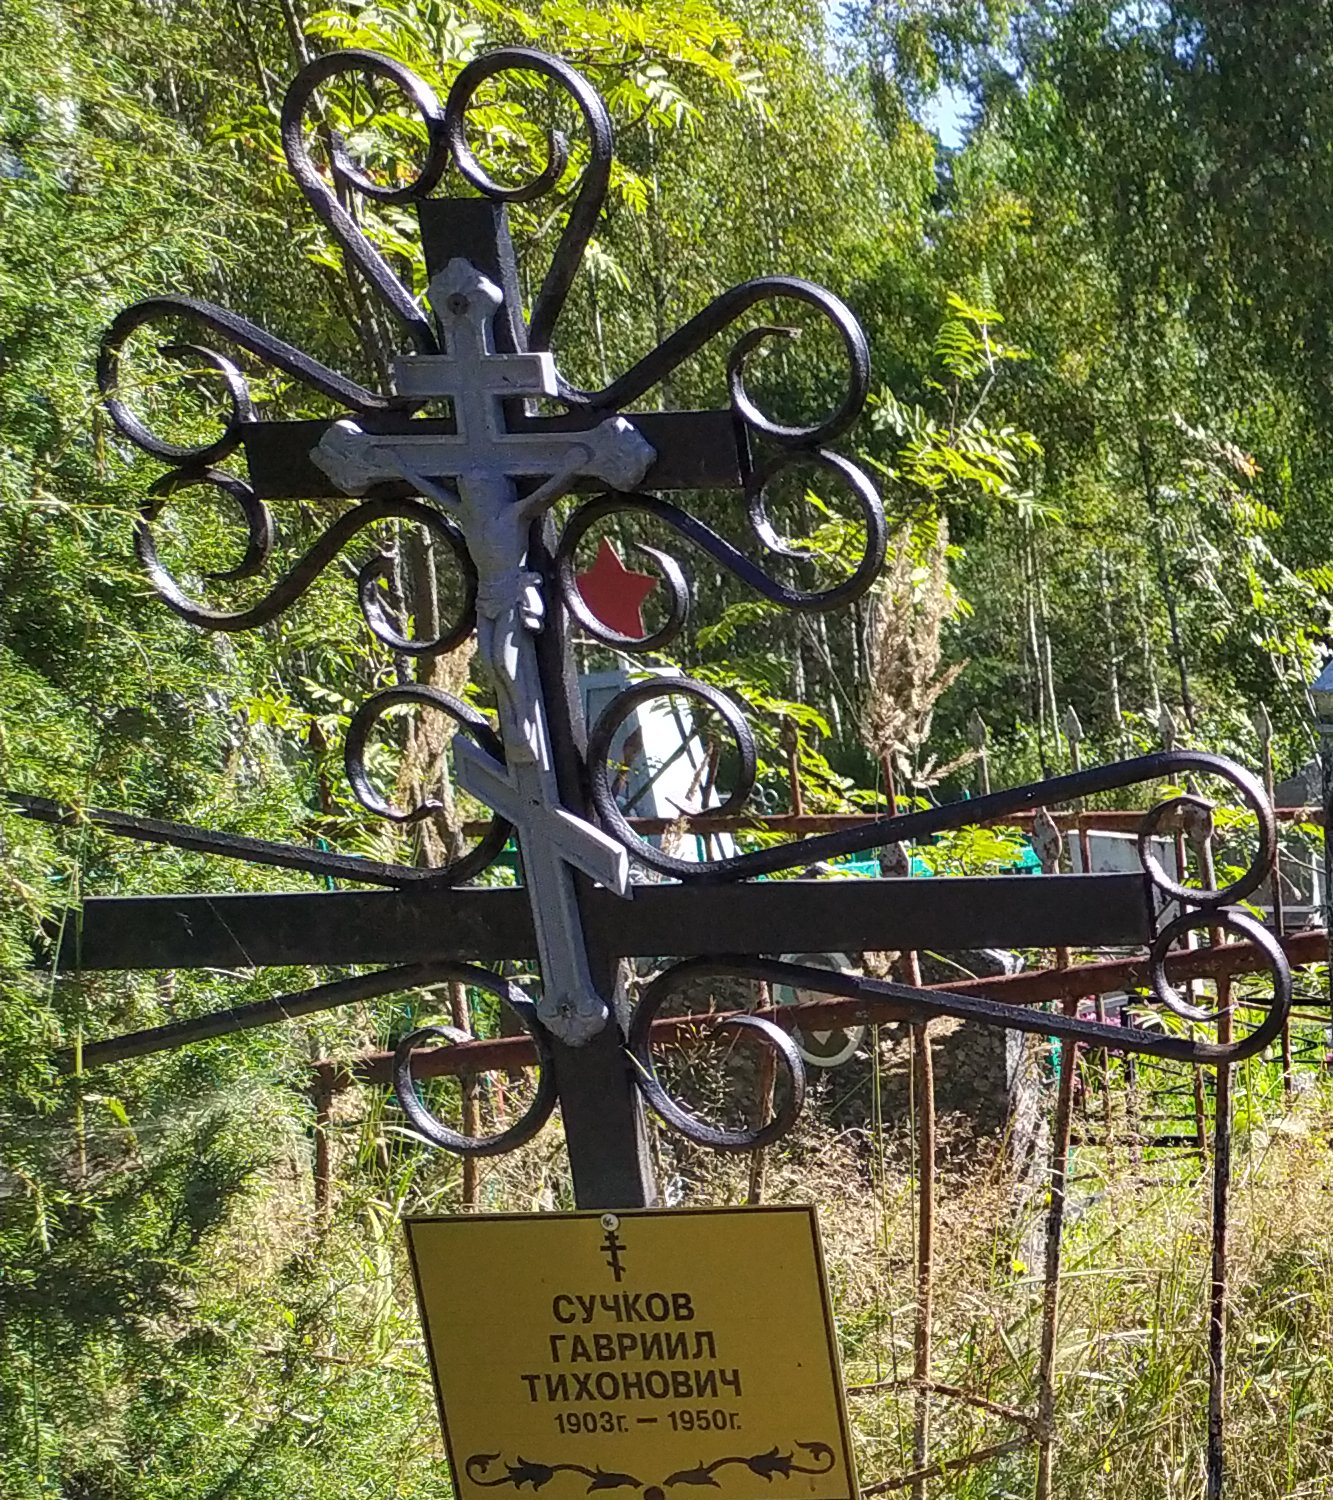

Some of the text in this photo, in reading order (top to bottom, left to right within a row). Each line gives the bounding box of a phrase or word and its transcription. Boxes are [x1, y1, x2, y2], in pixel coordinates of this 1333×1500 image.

[552, 1292, 694, 1324] СУЧКОВ
[548, 1331, 718, 1364] ГАВРИИЛ
[520, 1369, 743, 1403] ТИХОНОВИЧ
[553, 1411, 630, 1436] 1903г.
[666, 1409, 743, 1432] 1950г.
